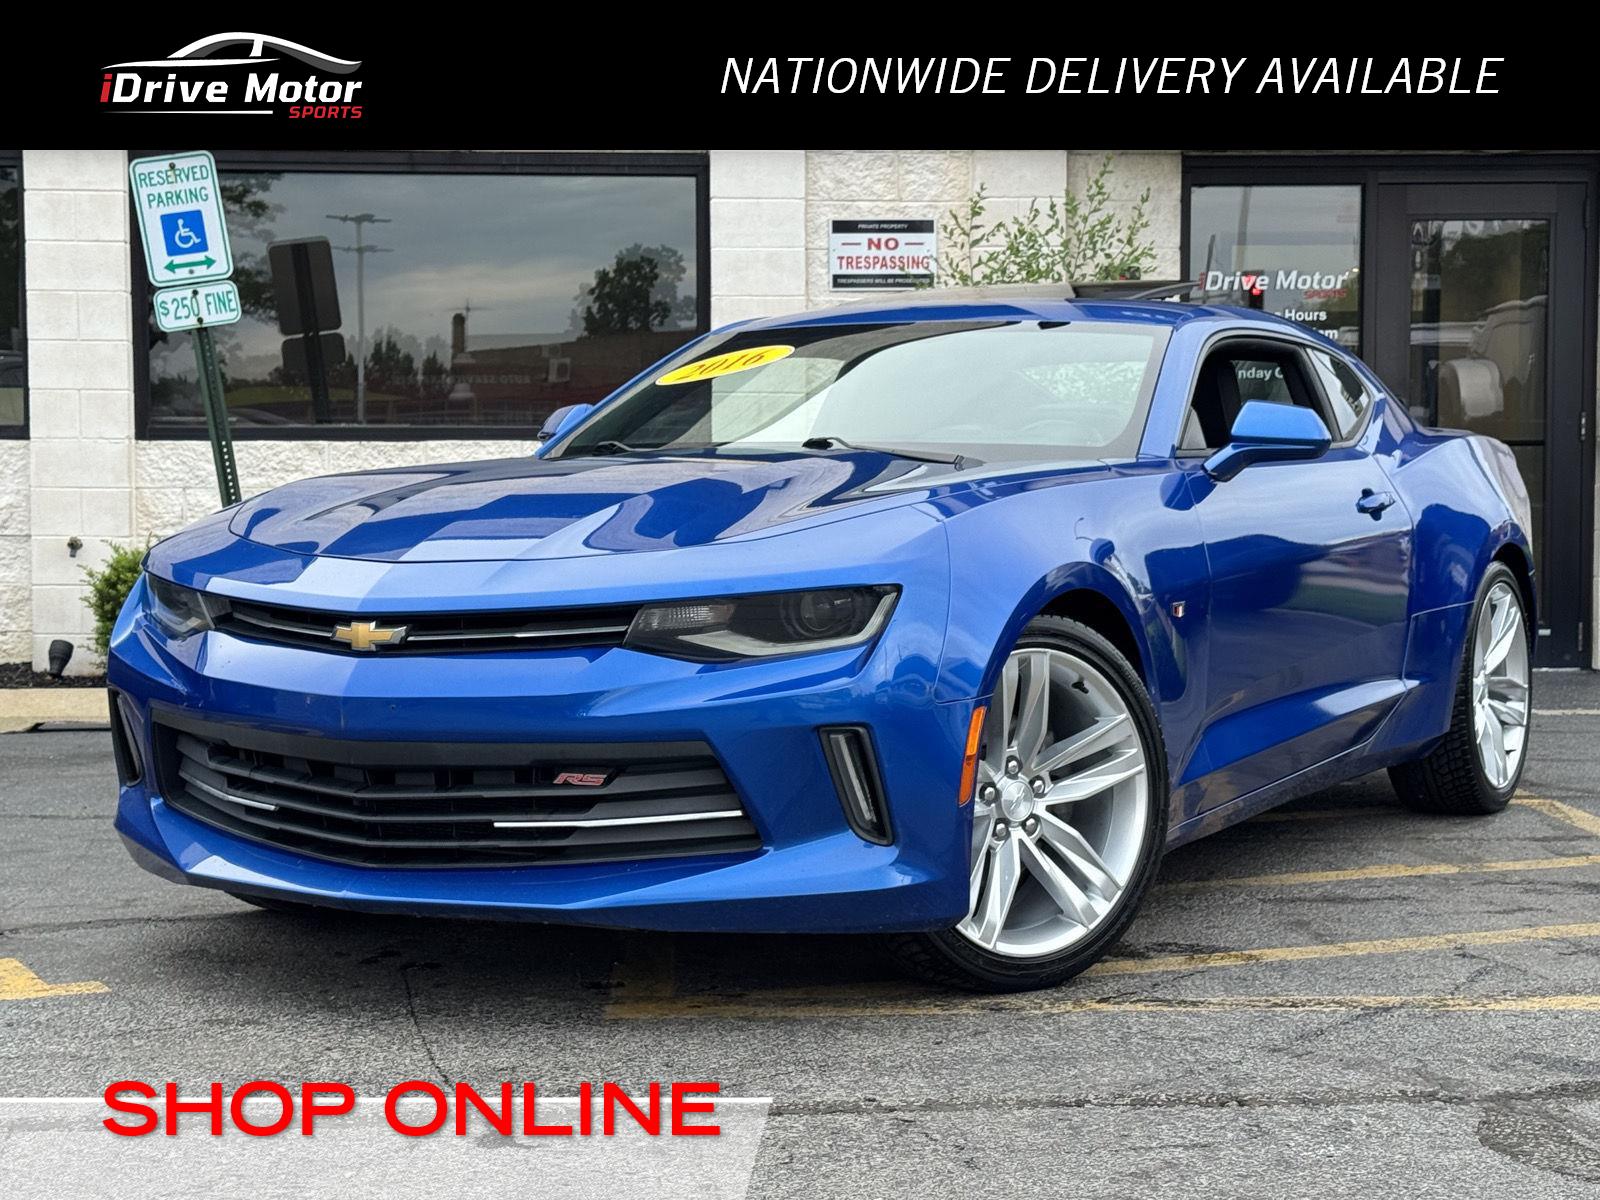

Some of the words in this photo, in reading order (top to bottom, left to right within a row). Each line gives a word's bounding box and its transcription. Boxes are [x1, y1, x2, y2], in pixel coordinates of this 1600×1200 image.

[138, 164, 209, 188] RESERVED
[147, 186, 209, 209] PARKING
[867, 237, 899, 251] NO
[837, 255, 930, 270] TRESPASSING
[1275, 270, 1350, 290] Motor
[159, 294, 200, 321] $250
[204, 290, 238, 316] FINE
[1285, 309, 1327, 321] Hours
[677, 351, 768, 380] 2016
[553, 772, 607, 786] RS
